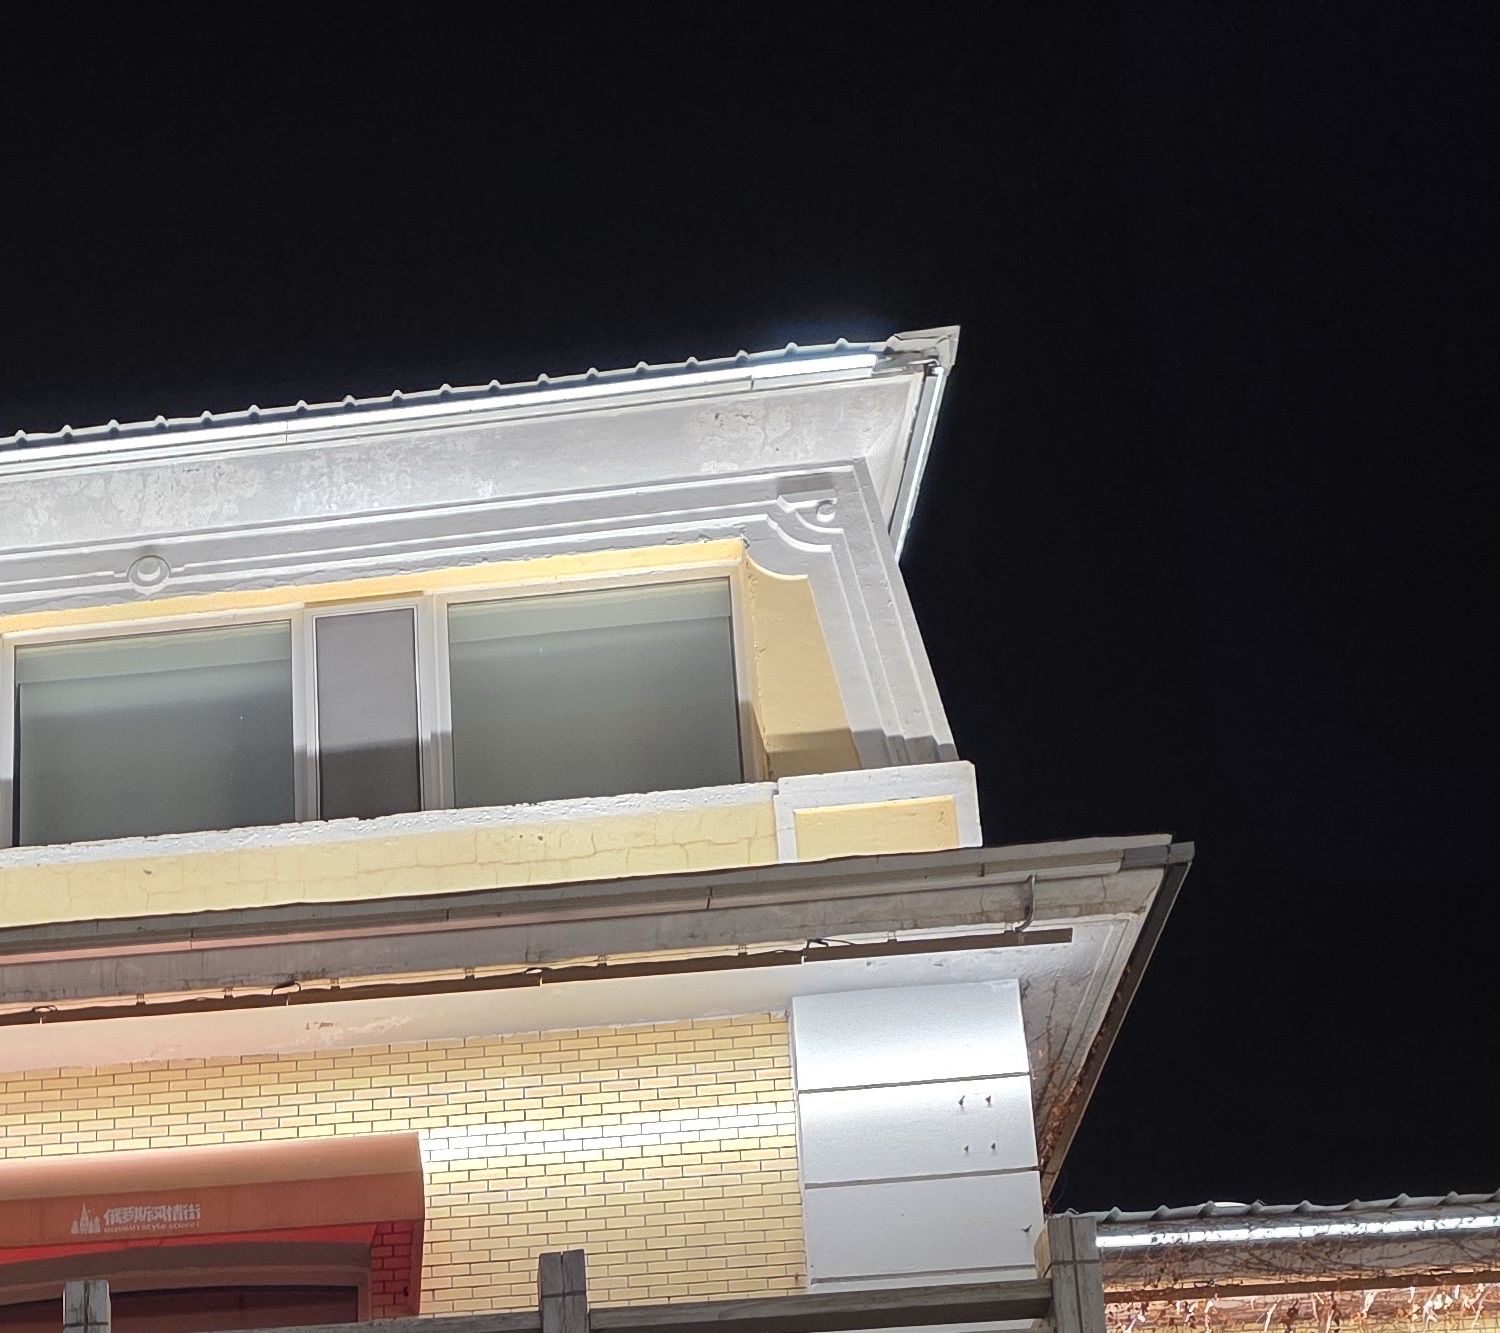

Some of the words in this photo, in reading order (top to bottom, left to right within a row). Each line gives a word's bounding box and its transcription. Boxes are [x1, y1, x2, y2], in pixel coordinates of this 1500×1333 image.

[103, 1203, 202, 1226] 俄罗斯风情街
